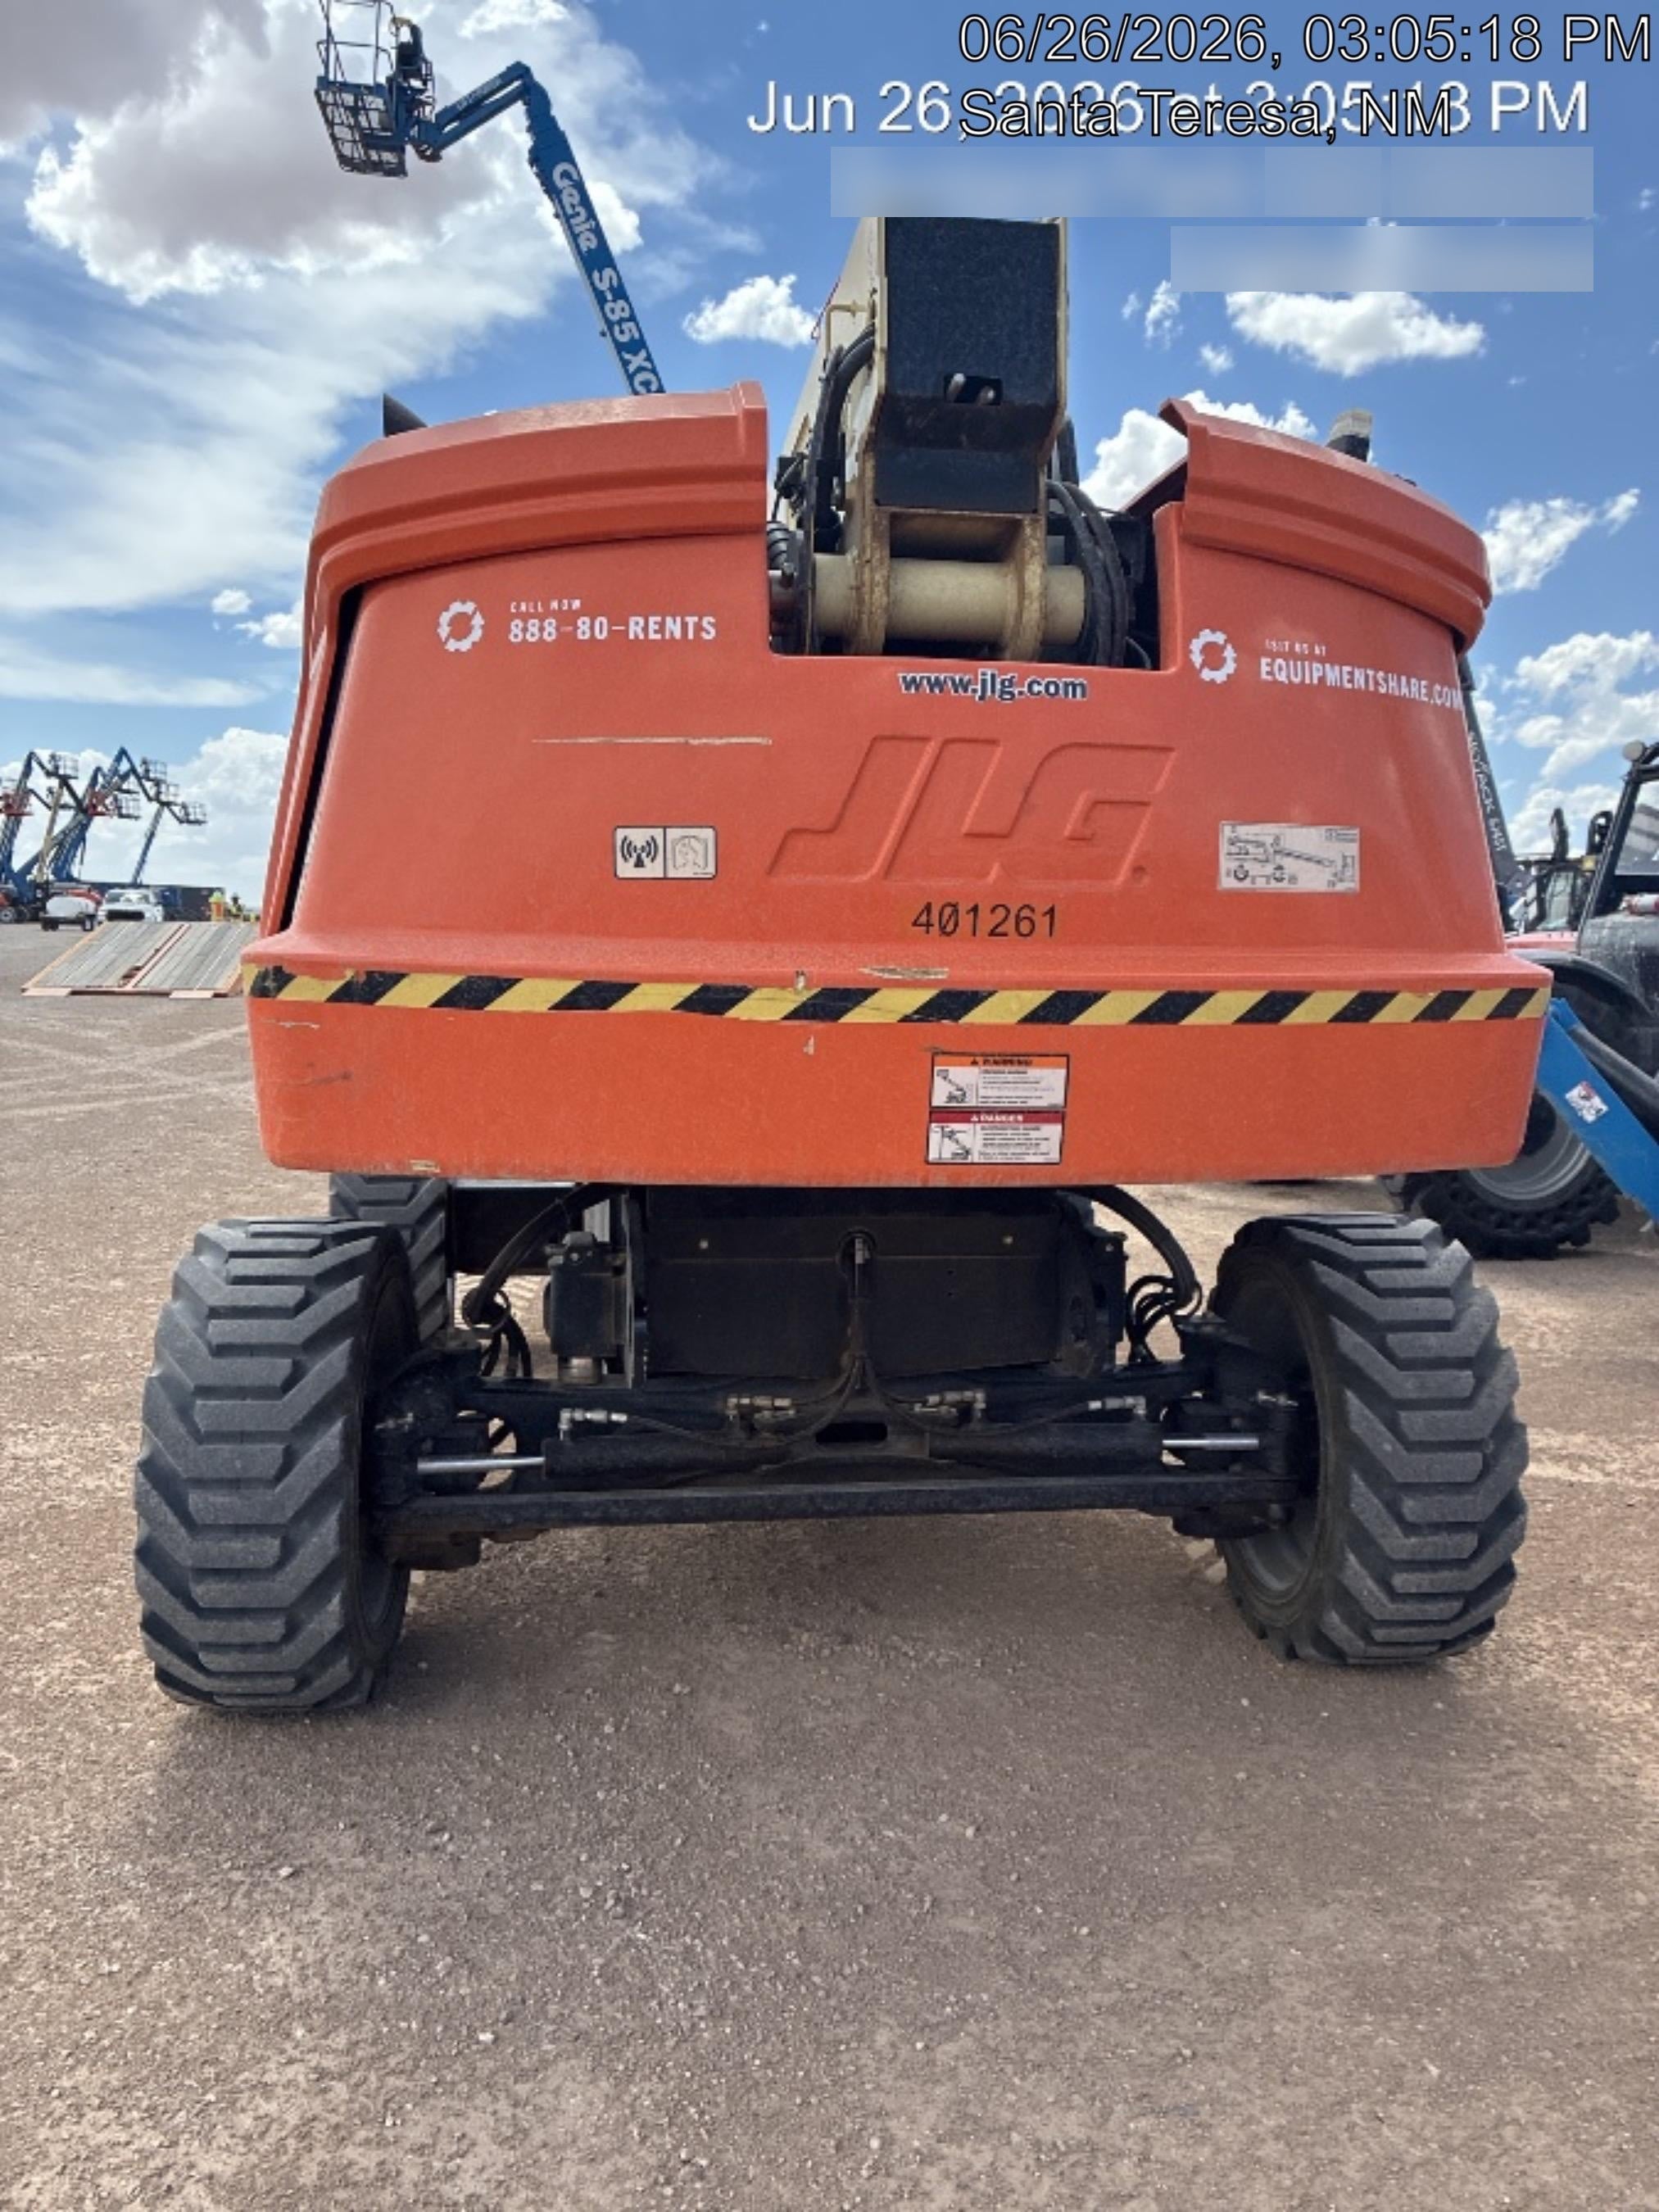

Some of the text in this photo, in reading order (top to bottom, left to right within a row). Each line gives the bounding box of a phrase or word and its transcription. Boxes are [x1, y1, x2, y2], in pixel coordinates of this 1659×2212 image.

[552, 161, 660, 393] Genie S-85 XC
[510, 599, 582, 613] CALL NOW
[509, 616, 717, 642] 888-80-RENTS
[899, 670, 1088, 700] www.jlg.com
[1260, 657, 1464, 711] EQUIPMENTSHARE.COM
[767, 734, 1176, 890] JLG
[911, 901, 1058, 937] 401261
